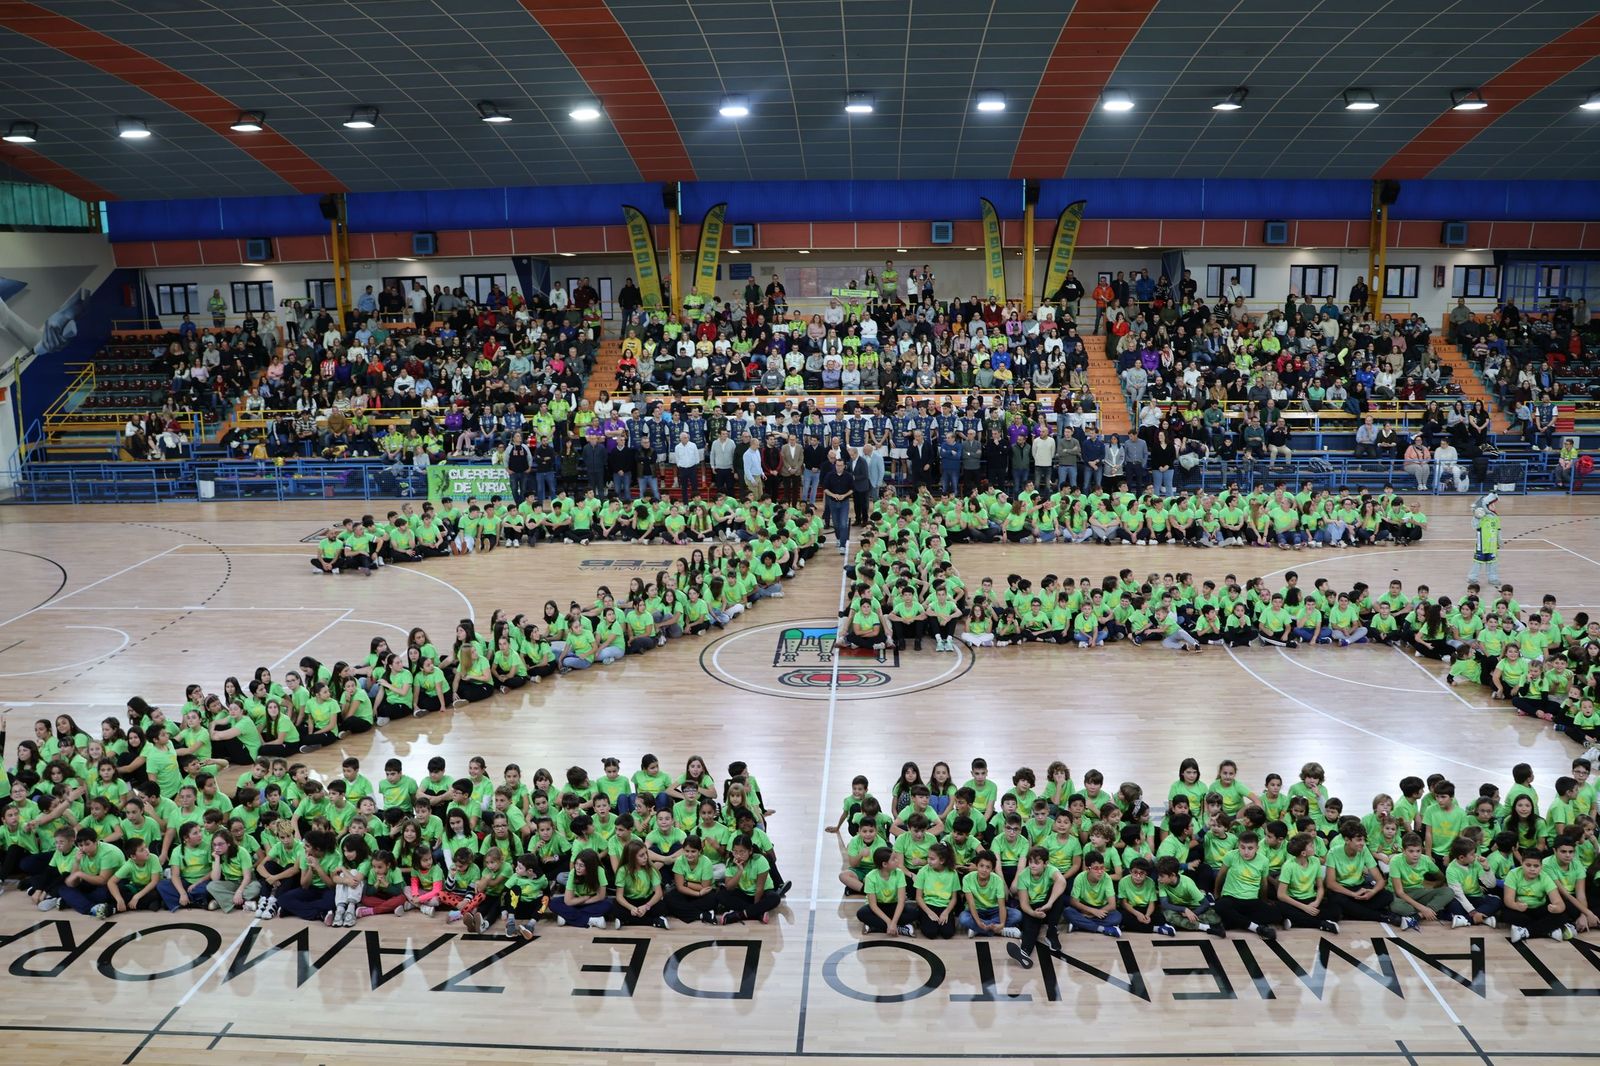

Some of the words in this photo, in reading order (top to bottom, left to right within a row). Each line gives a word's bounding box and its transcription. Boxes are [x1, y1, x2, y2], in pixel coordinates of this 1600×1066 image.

[455, 482, 471, 492] DE
[570, 937, 762, 1000] DE
[822, 936, 1600, 1003] TAMIENTO
